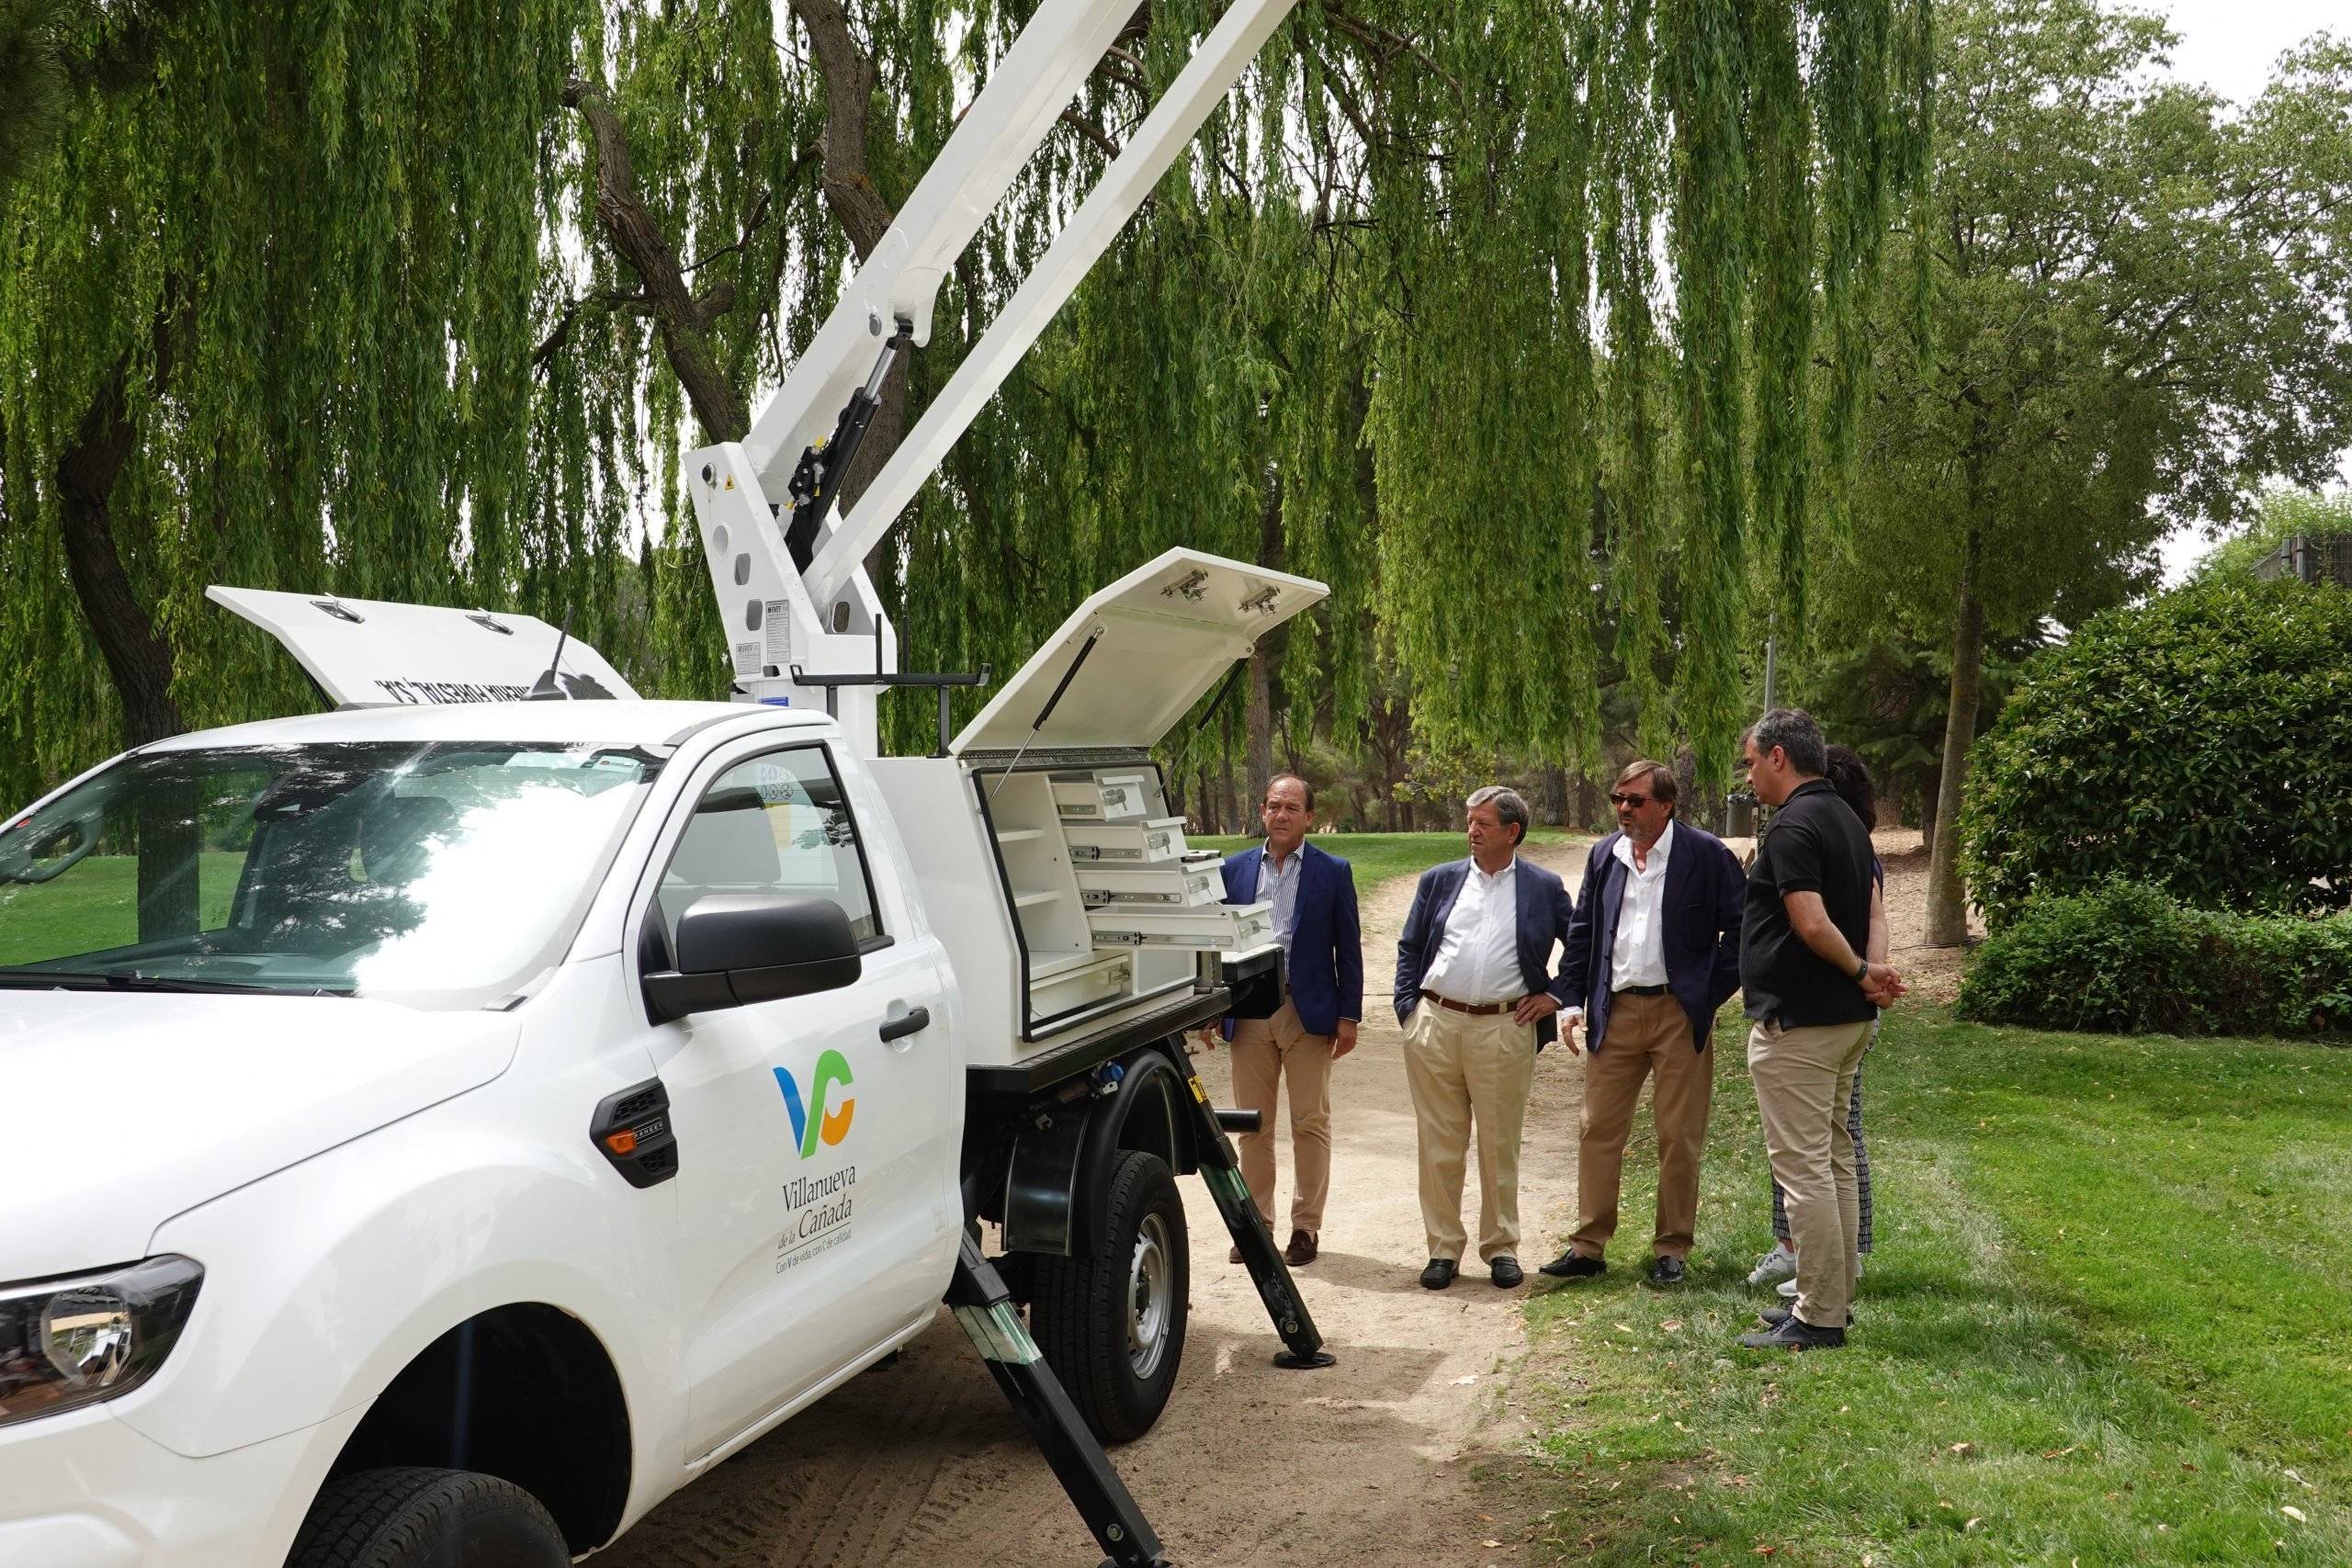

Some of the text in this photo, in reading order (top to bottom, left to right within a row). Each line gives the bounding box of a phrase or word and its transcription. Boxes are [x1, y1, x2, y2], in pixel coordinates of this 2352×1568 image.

[634, 1122, 662, 1139] RANGER
[783, 1166, 855, 1213] Villanueva
[778, 1193, 853, 1249] de la Cañada
[776, 1261, 787, 1274] Con
[787, 1257, 792, 1269] V
[793, 1255, 799, 1266] de
[827, 1236, 833, 1249] de
